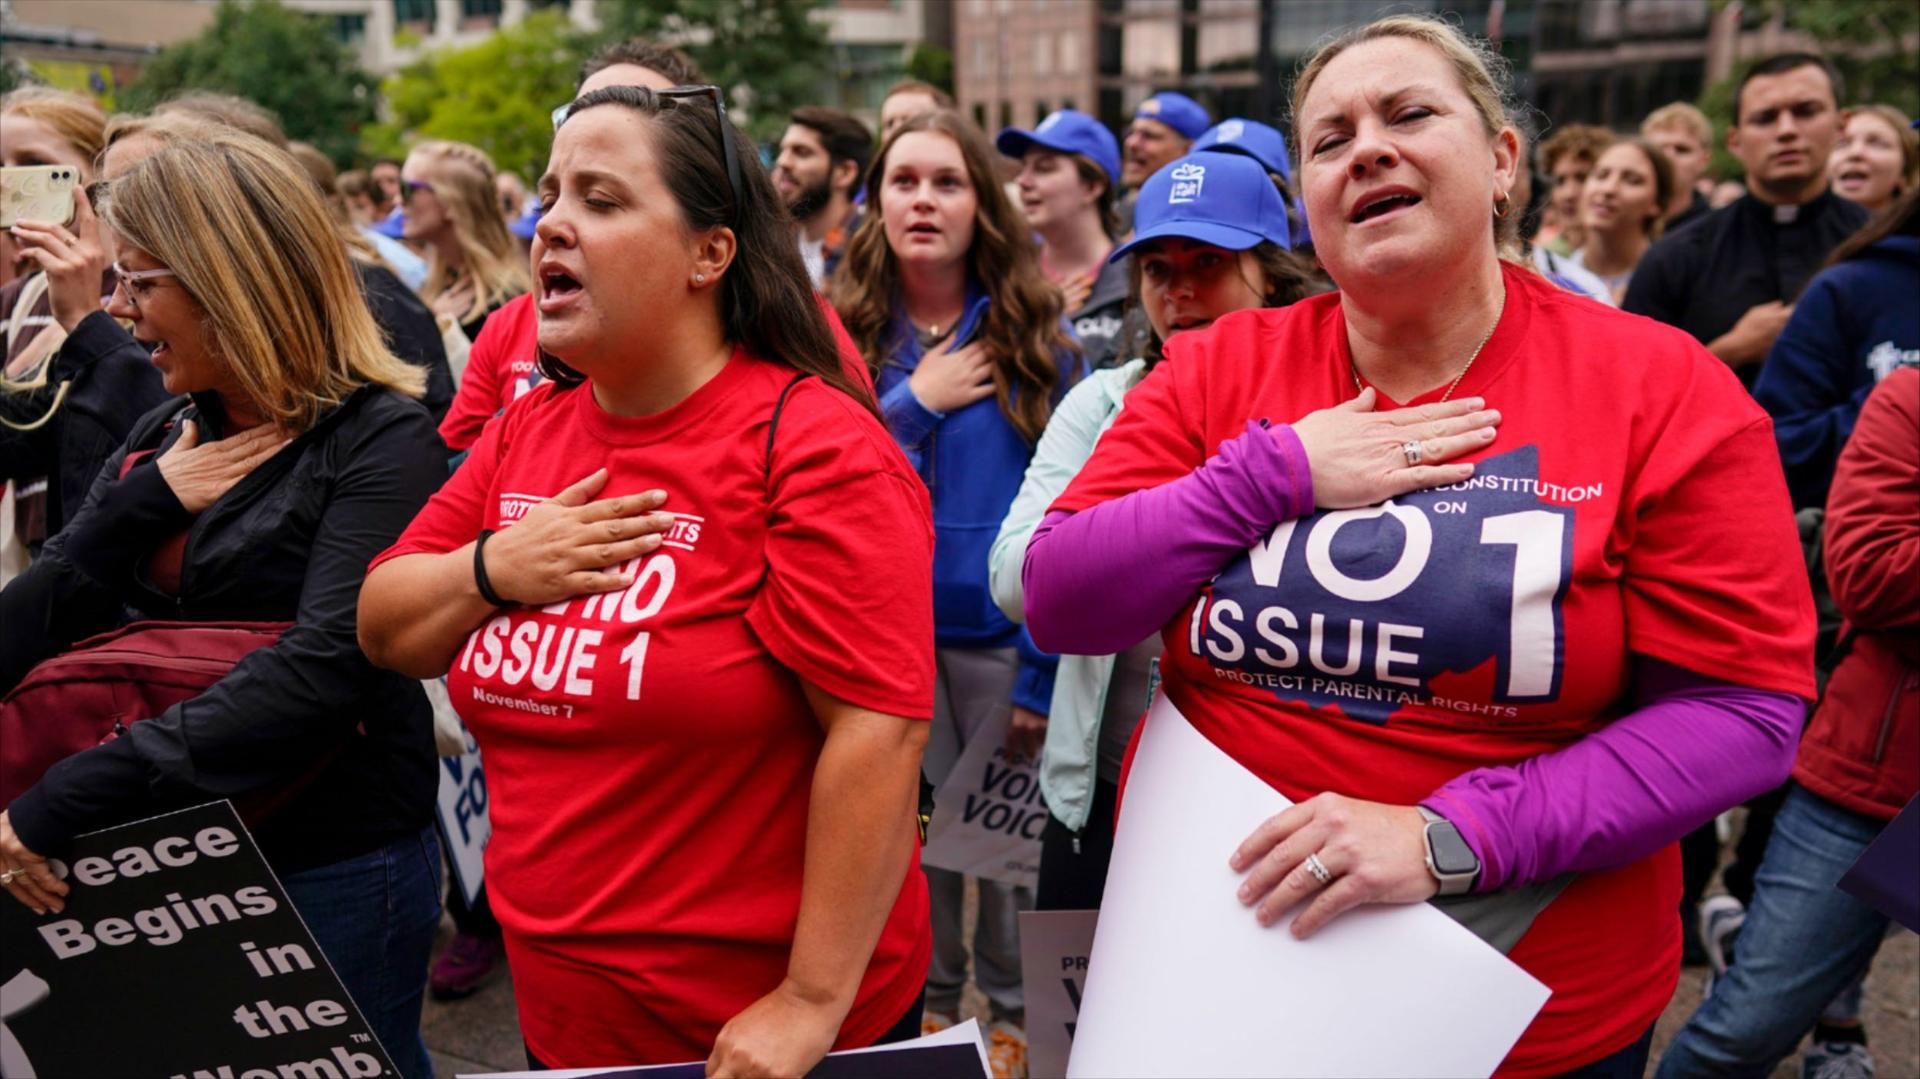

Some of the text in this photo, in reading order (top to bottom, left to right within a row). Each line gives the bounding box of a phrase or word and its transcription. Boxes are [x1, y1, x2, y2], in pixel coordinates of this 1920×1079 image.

[1433, 501, 1468, 514] ON
[1435, 475, 1603, 502] ONSTITUTION
[1480, 510, 1565, 697] 1
[460, 616, 650, 700] ISSUE 1
[1190, 594, 1425, 687] ISSUE
[473, 686, 574, 719] November 7
[1214, 667, 1518, 718] PROTECT PARENTAL RIGHTS
[962, 794, 1048, 842] VOIC
[48, 826, 240, 887] eace
[37, 885, 278, 960] Begins
[240, 941, 316, 978] in
[232, 1000, 349, 1039] the
